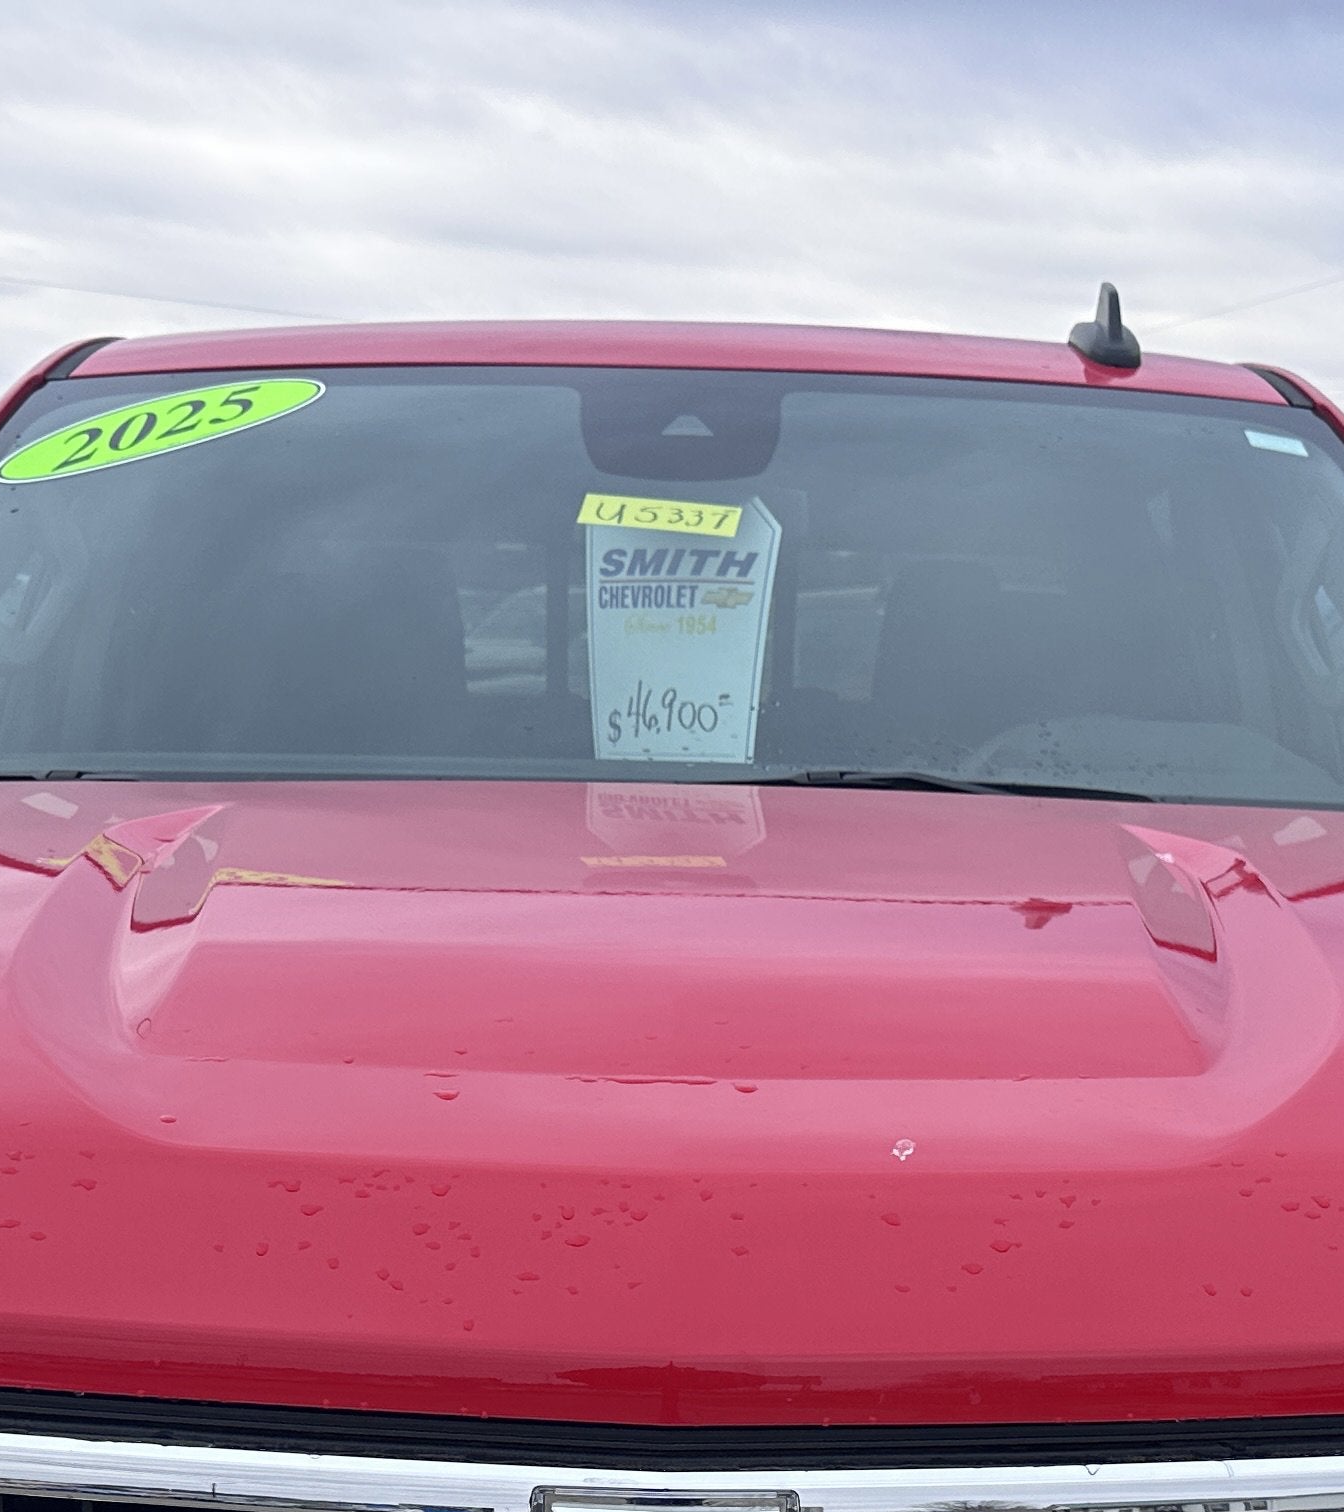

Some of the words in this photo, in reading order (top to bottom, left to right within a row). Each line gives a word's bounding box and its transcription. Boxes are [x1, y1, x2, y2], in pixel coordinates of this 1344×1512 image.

[51, 386, 262, 472] 2025
[599, 548, 759, 577] SMITH
[598, 584, 699, 609] CHEVROLET
[676, 614, 717, 634] 1954
